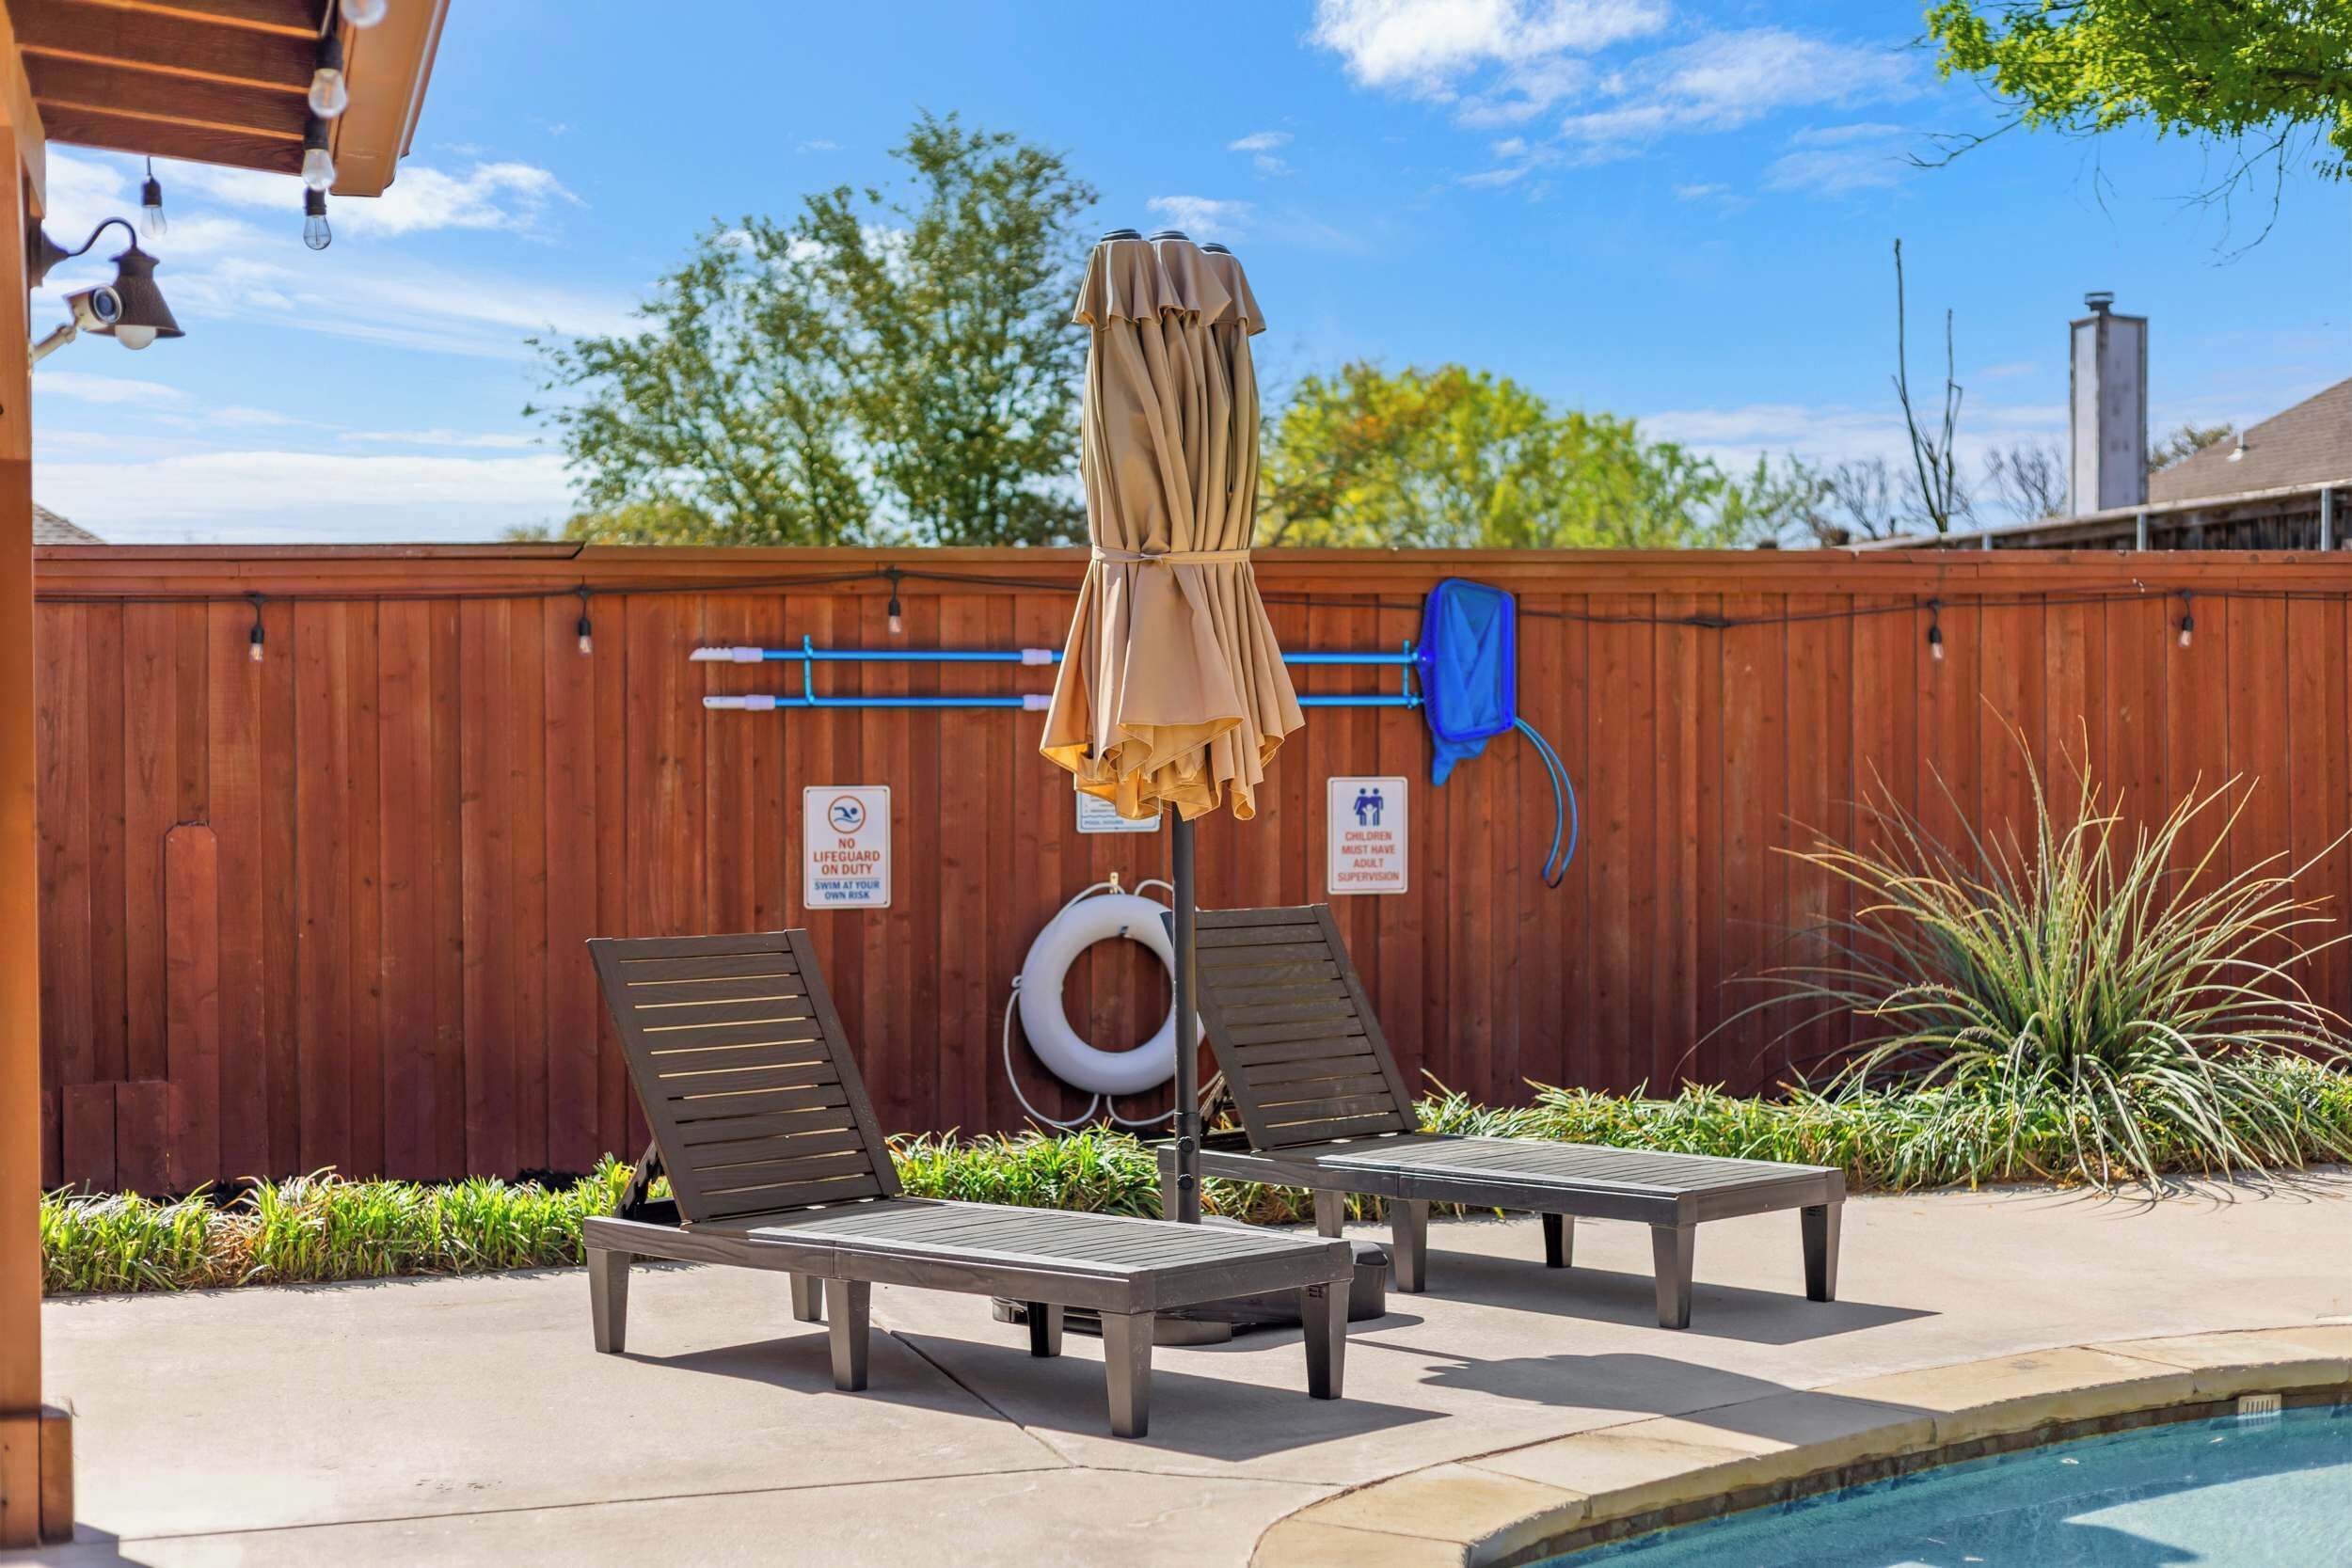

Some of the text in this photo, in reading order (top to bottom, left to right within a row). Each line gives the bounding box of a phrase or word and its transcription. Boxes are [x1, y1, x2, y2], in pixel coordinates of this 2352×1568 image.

[1345, 832, 1392, 841] CHILDREN
[838, 838, 855, 848] NO
[1342, 845, 1396, 855] MUST HAVE
[813, 850, 881, 863] LIFEGUARD
[1353, 858, 1385, 868] ADULT
[821, 863, 873, 875] ON DUTY
[1338, 872, 1400, 881] SUPERVISION
[815, 881, 840, 890] SWIM
[855, 880, 880, 889] YOUR
[824, 891, 870, 900] OWN RISK
